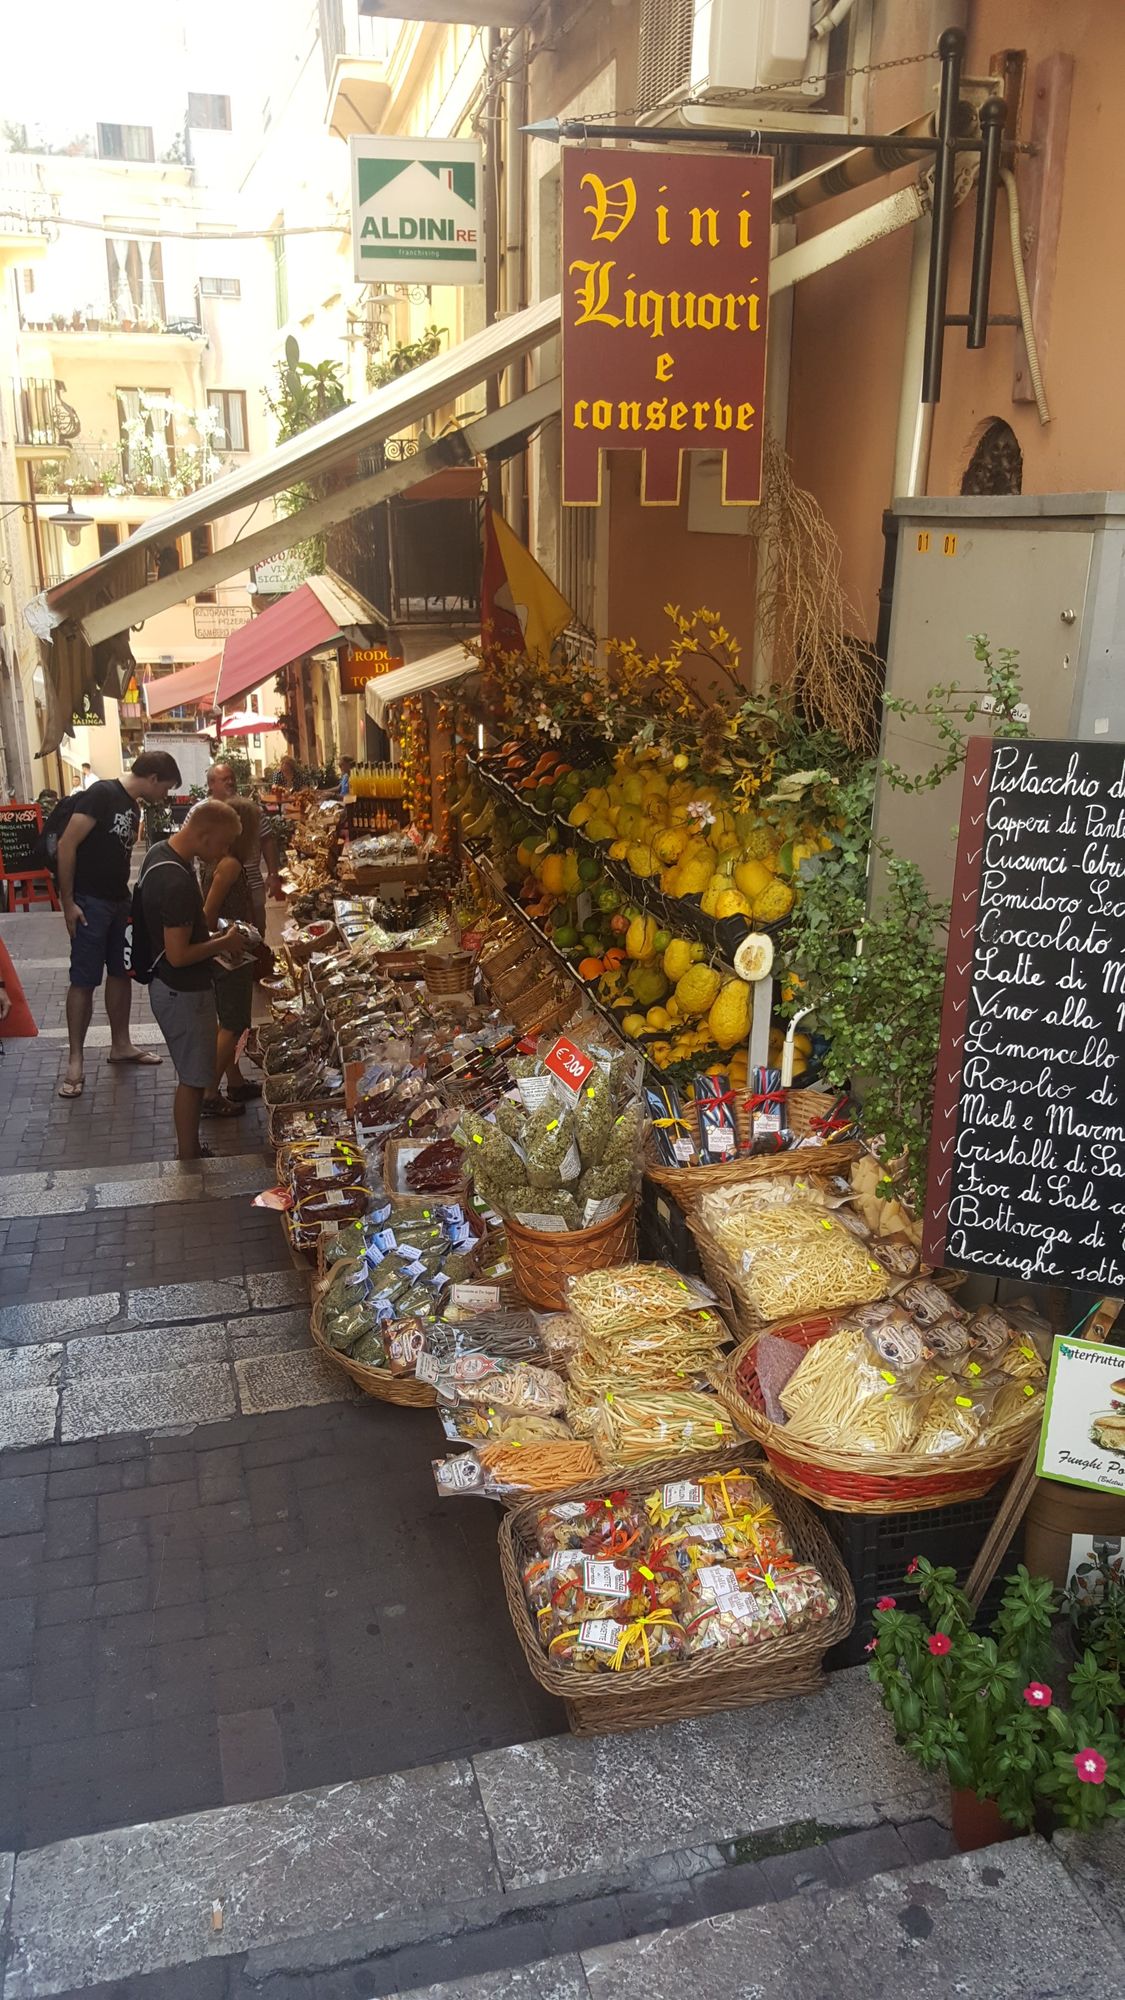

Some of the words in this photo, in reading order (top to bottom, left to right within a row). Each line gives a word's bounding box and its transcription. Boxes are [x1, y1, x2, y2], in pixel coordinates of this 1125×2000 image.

[360, 216, 455, 241] ALDINI
[456, 229, 477, 242] RE
[580, 172, 753, 248] Vini
[399, 248, 440, 258] franchising
[568, 260, 761, 338] Liquori
[655, 352, 675, 382] e
[572, 396, 756, 432] conserve
[374, 662, 390, 673] DI
[989, 746, 1100, 796] Pistacchio
[986, 796, 1051, 842] Capperi
[1056, 805, 1077, 834] di
[985, 834, 1067, 874] Cucunci
[980, 870, 1082, 912] Pomidoro
[974, 947, 1045, 986] Latte
[1056, 957, 1087, 990] di
[972, 986, 1038, 1021] Vino
[1041, 995, 1102, 1029] alla
[964, 1019, 1119, 1068] Limoncello
[963, 1056, 1076, 1099] Rosolio
[1086, 1075, 1117, 1106] di
[960, 1093, 1016, 1130] Miele
[1022, 1115, 1033, 1130] e
[1046, 1104, 1125, 1142] Marm
[954, 1128, 1058, 1170] Cristalli
[1063, 1144, 1087, 1173] di
[957, 1162, 1010, 1199] Fior
[1017, 1174, 1042, 1203] di
[1047, 1175, 1100, 1211] Sale
[947, 1195, 1072, 1254] Bottarga
[1079, 1220, 1106, 1248] di
[945, 1230, 1064, 1280] Acciughe
[1071, 1257, 1125, 1286] sotto
[1058, 1450, 1103, 1470] Funghi
